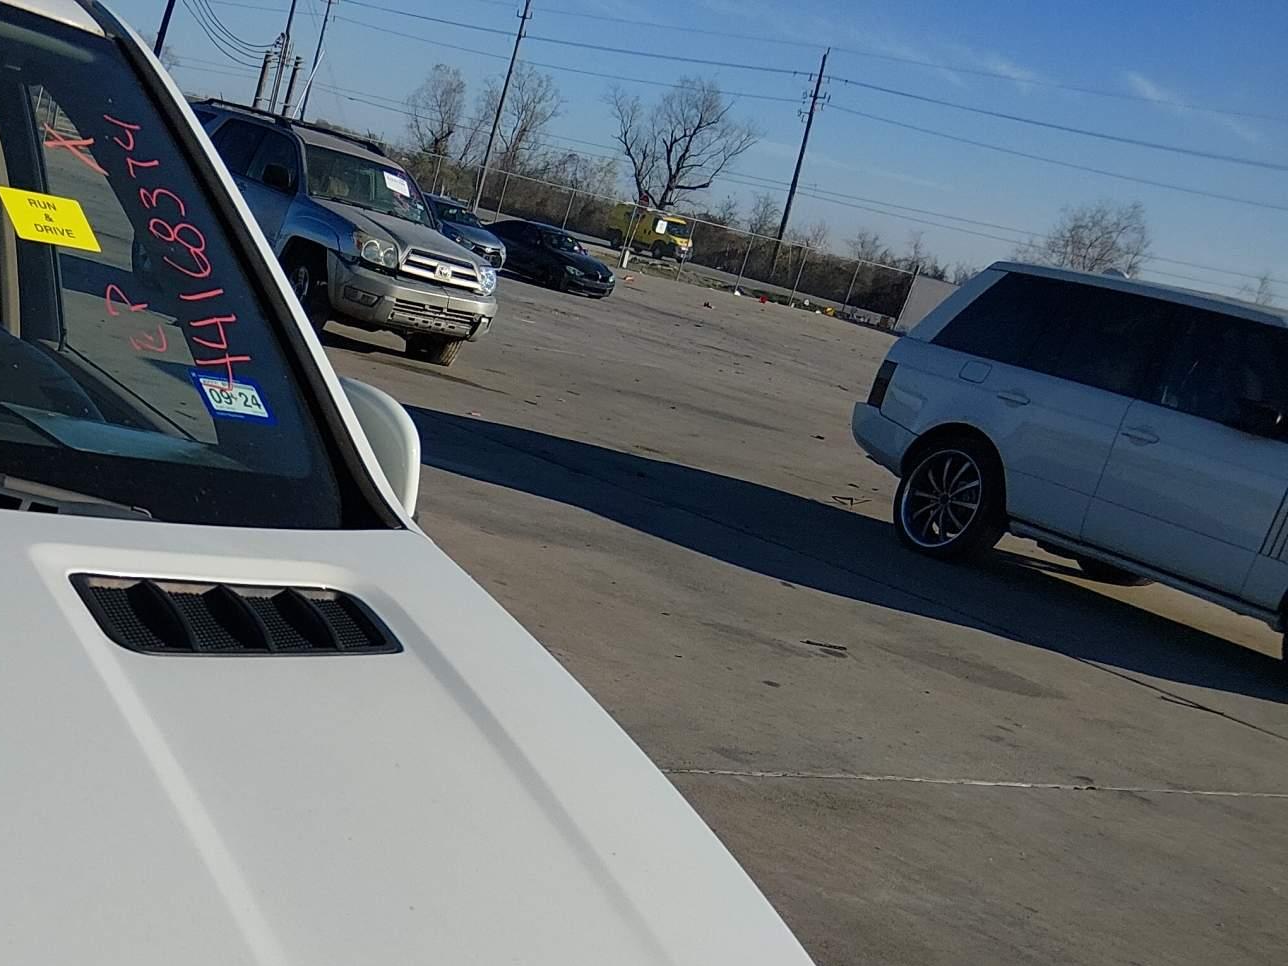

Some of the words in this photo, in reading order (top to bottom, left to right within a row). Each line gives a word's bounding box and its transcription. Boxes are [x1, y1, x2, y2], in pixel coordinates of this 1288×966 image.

[27, 198, 57, 212] RUN
[43, 213, 54, 223] &
[33, 223, 76, 239] DRIVE
[103, 114, 251, 391] 44168374
[209, 388, 233, 406] 09
[238, 391, 262, 410] 24
